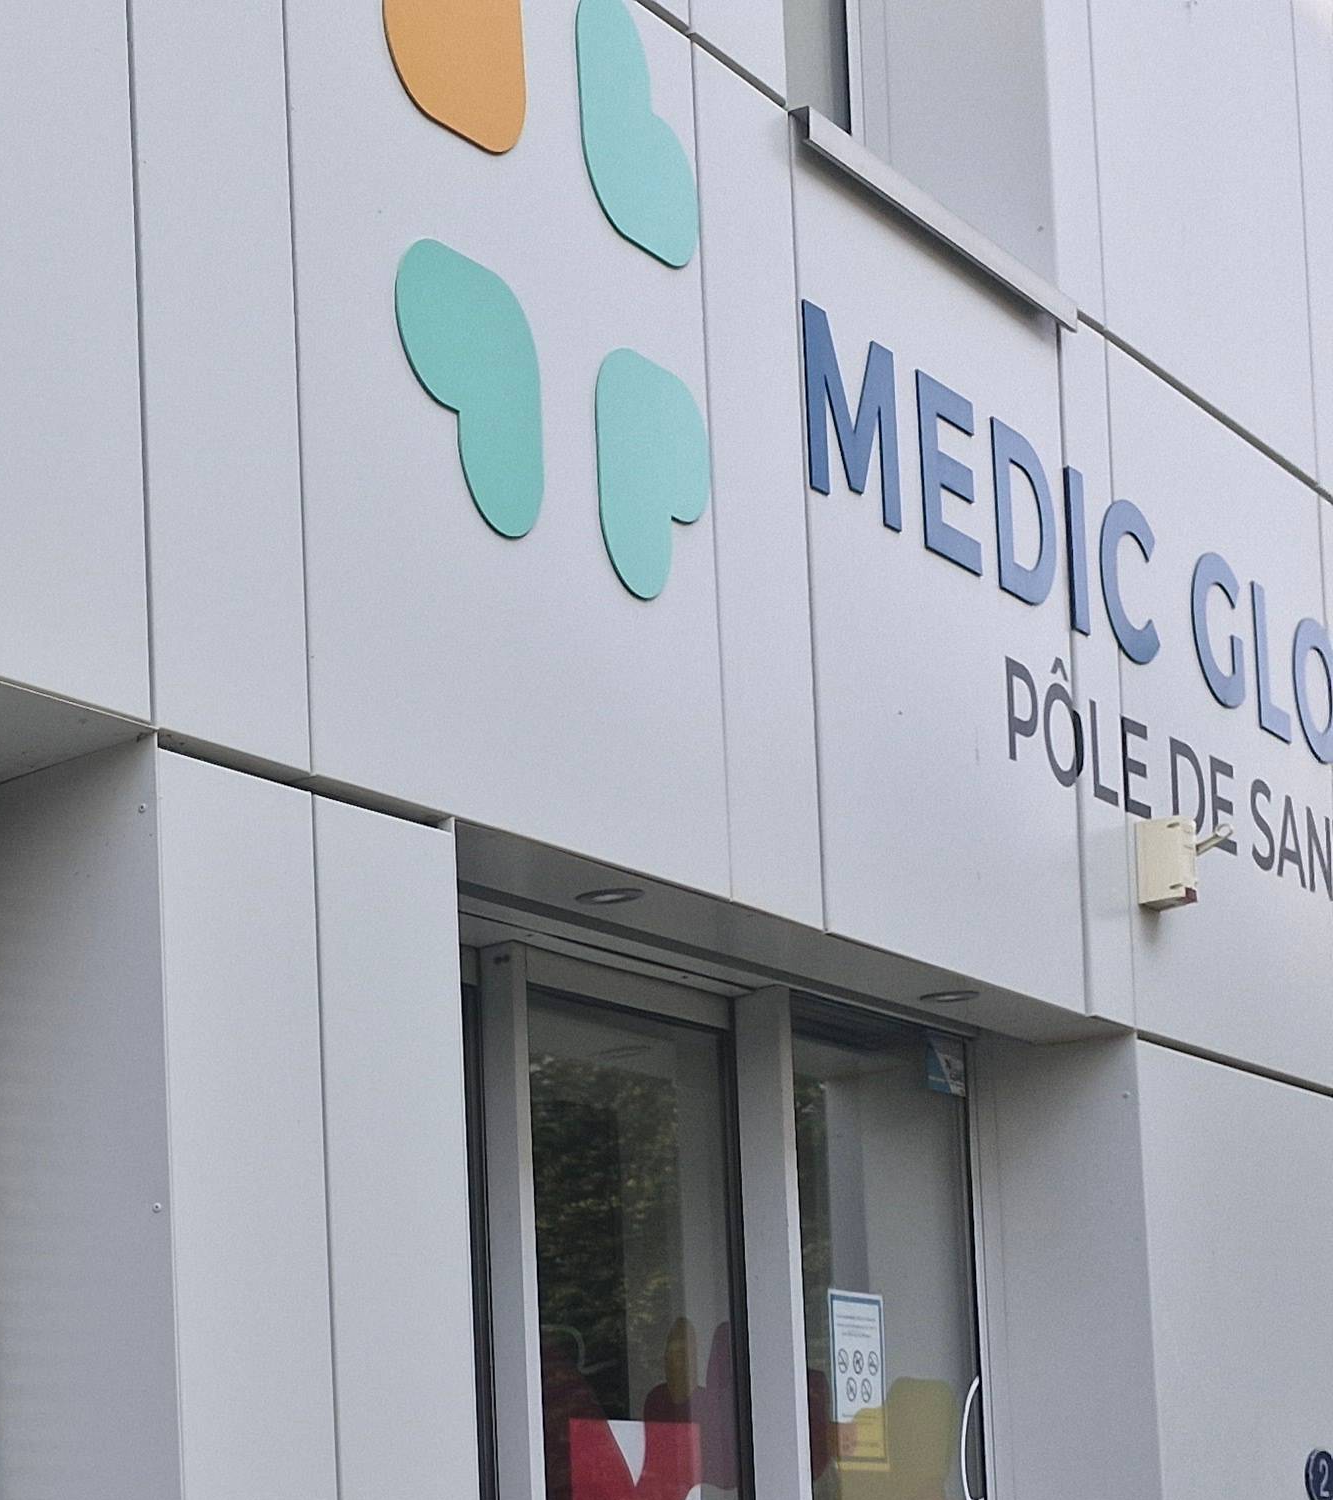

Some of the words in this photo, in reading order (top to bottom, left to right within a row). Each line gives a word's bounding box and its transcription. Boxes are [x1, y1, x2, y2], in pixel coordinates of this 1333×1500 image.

[801, 298, 1161, 666] MEDIC
[1005, 656, 1153, 820] PÔLE
[1169, 735, 1238, 856] DE
